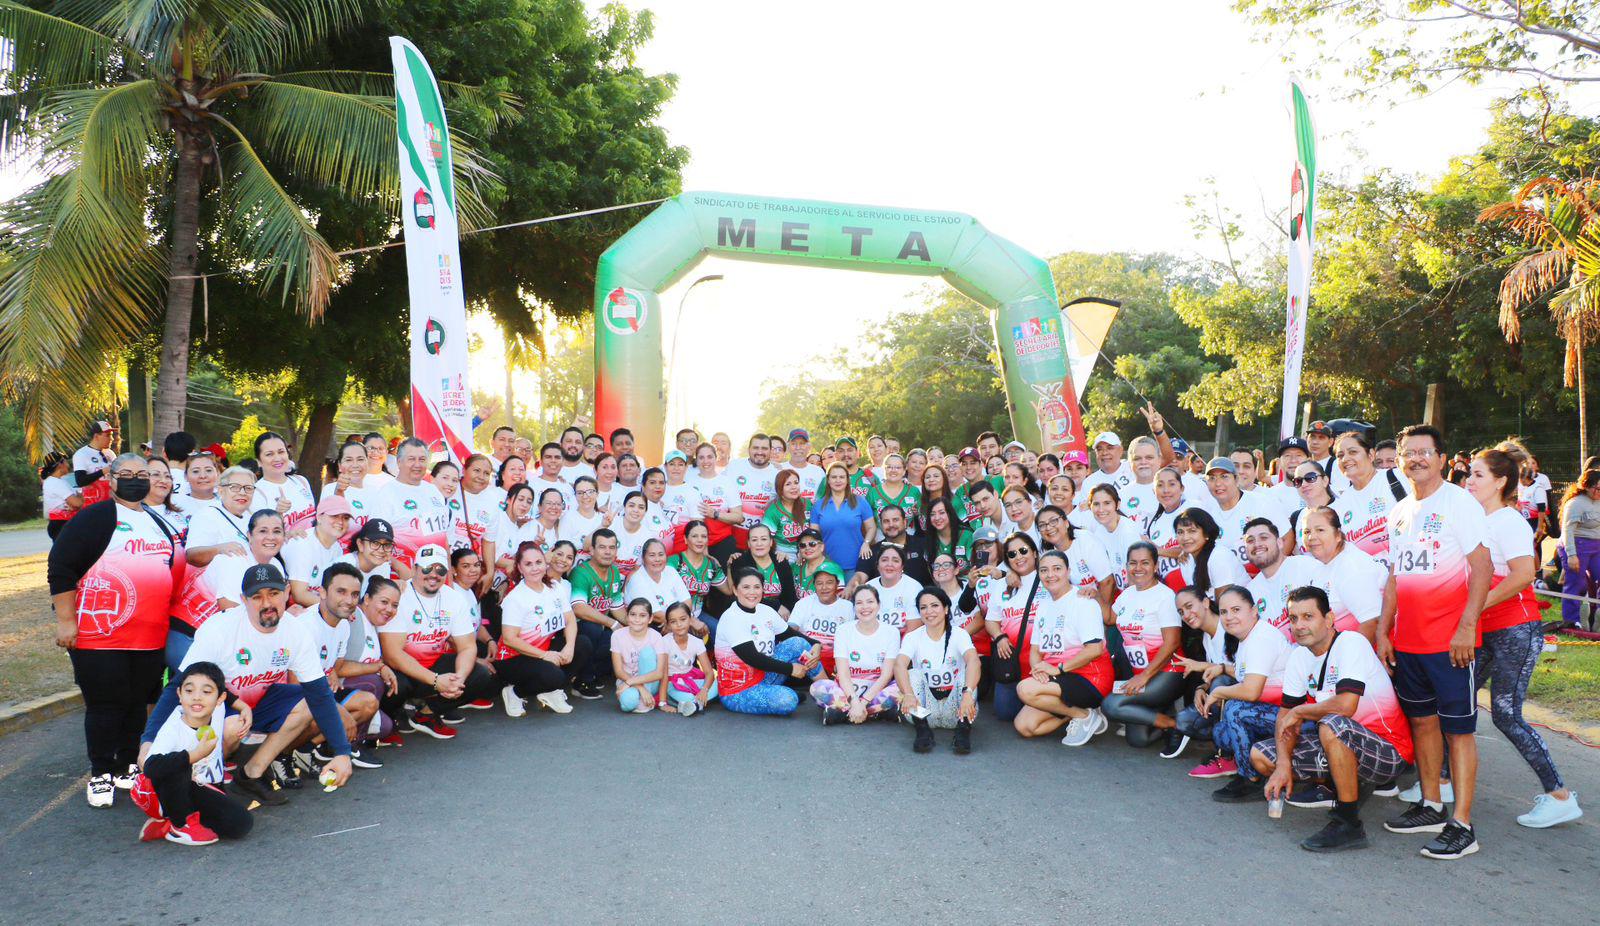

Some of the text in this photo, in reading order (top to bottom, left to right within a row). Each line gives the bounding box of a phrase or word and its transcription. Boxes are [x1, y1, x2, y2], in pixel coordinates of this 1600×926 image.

[694, 196, 961, 225] SINDICATO DE TRABAJADORES AL SERVICIO DEL ESTADO
[717, 216, 931, 262] META
[1016, 347, 1025, 356] DE
[1345, 515, 1388, 543] Mazatlán
[1397, 549, 1430, 572] 134
[545, 613, 563, 633] 191
[812, 618, 837, 634] 098
[1042, 633, 1063, 650] 243
